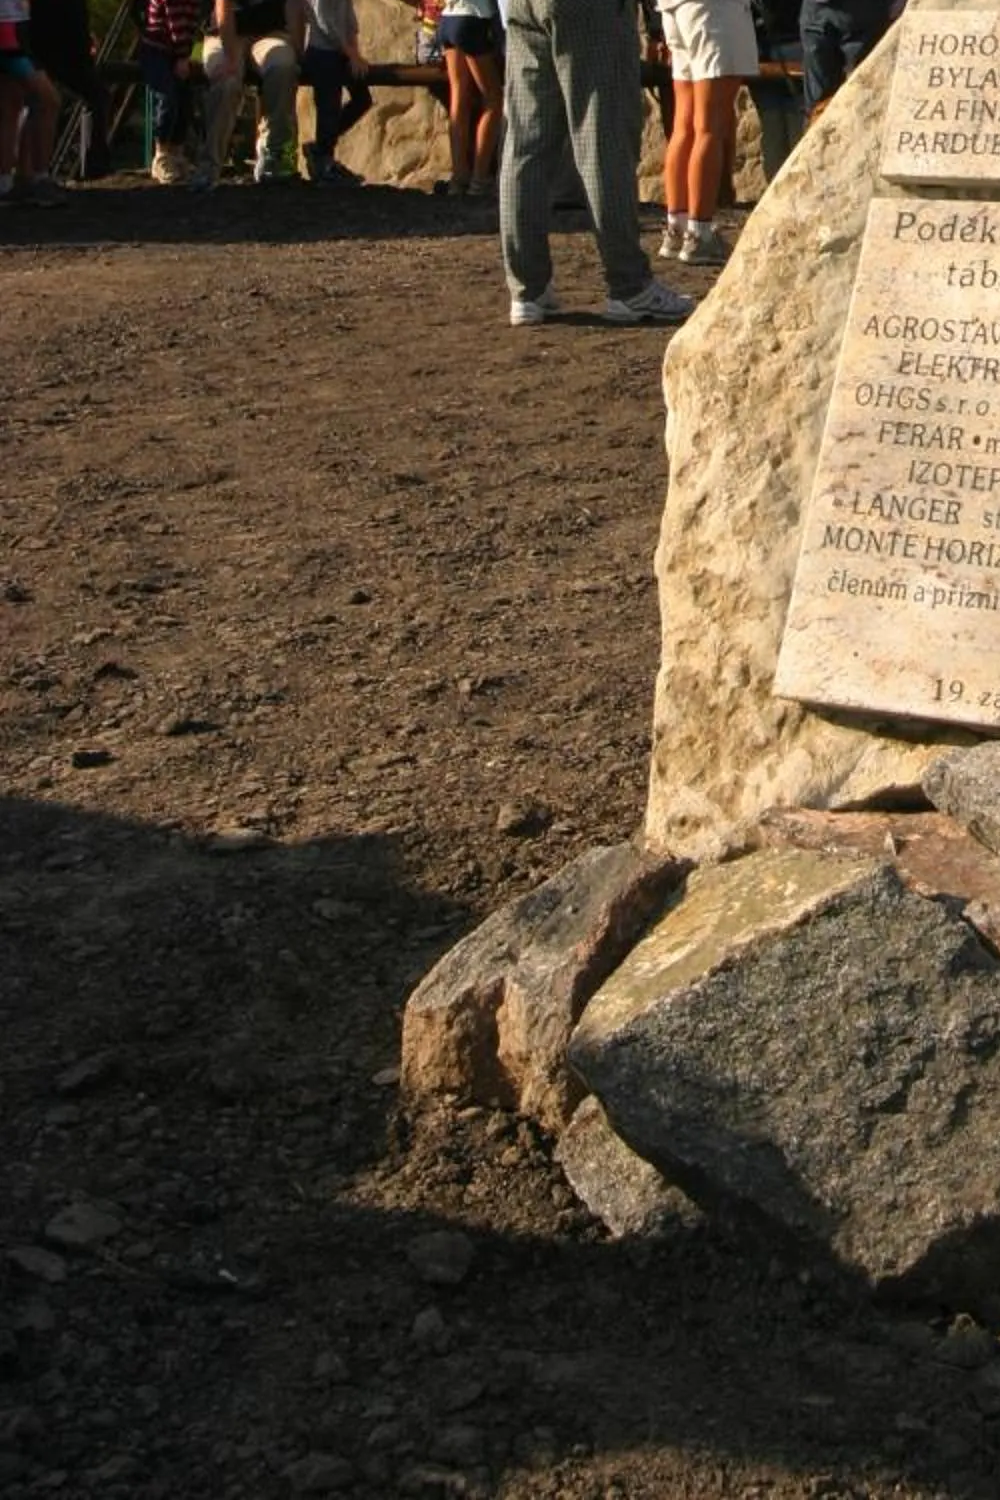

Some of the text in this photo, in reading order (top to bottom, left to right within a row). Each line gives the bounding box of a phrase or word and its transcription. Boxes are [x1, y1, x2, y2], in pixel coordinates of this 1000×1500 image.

[928, 65, 998, 89] BYLA
[913, 99, 947, 121] ZA
[855, 383, 932, 411] OHGS
[878, 421, 965, 450] FERAR
[852, 491, 963, 525] LANGER
[821, 524, 919, 560] MONTE
[827, 569, 907, 600] členům
[912, 585, 925, 603] a
[934, 678, 970, 705] 19.
